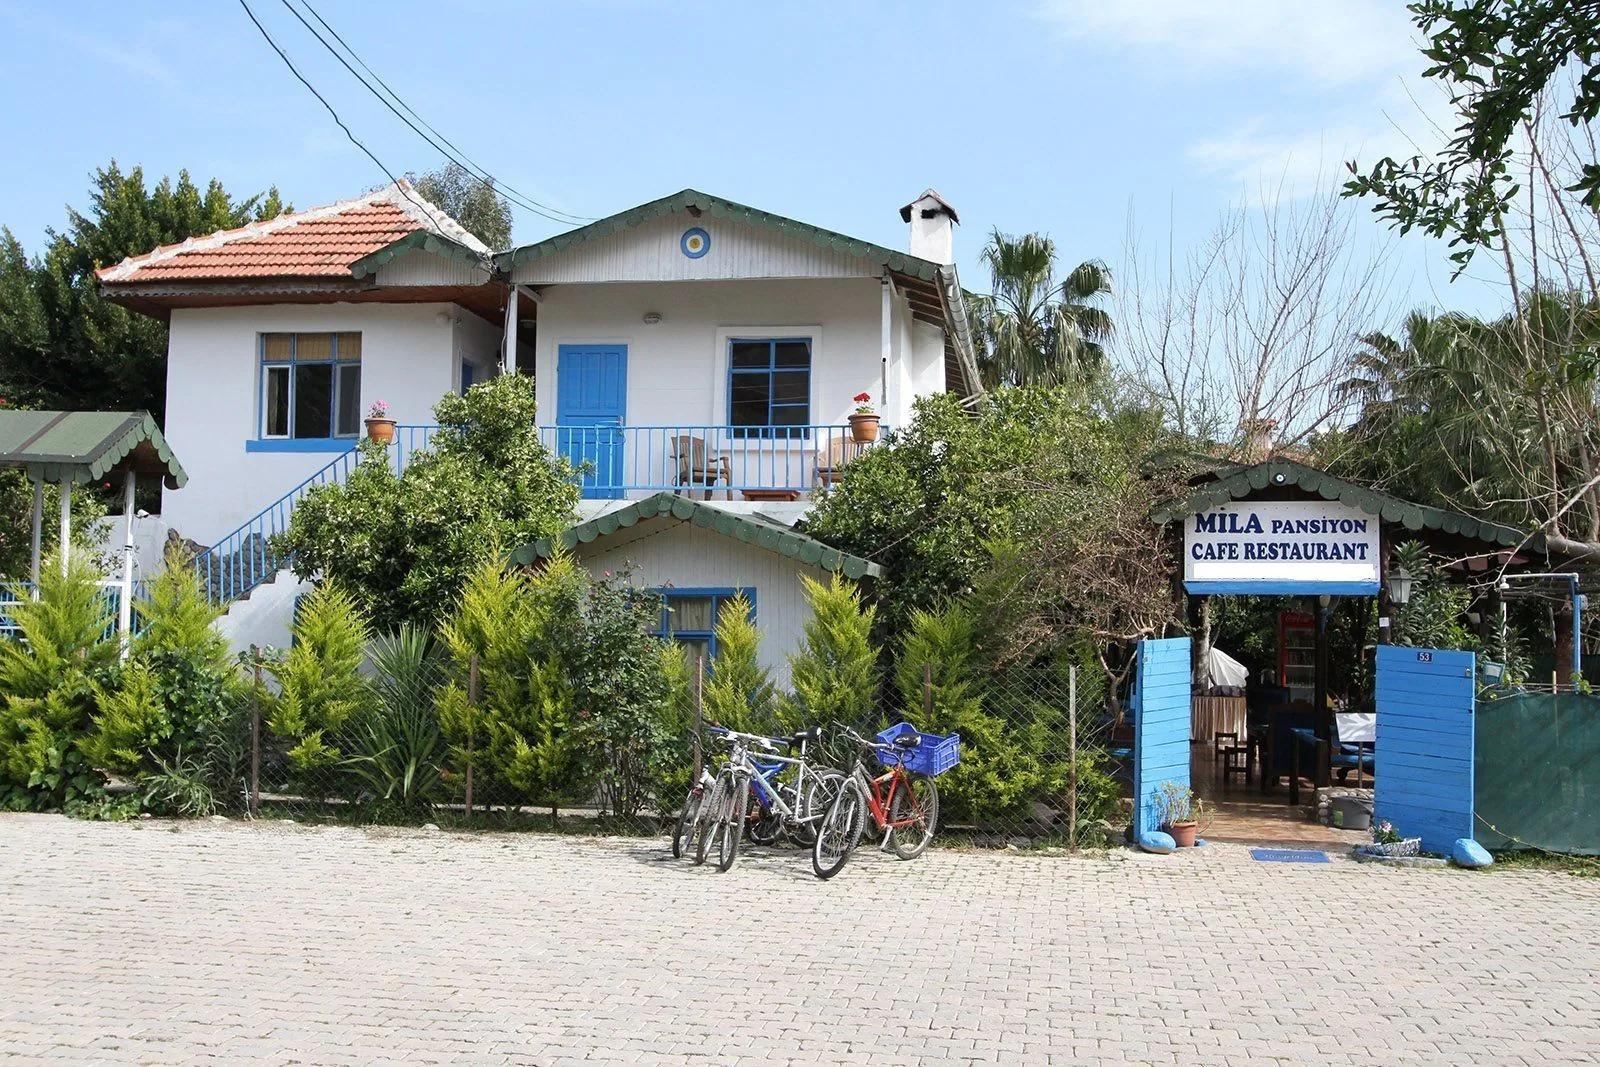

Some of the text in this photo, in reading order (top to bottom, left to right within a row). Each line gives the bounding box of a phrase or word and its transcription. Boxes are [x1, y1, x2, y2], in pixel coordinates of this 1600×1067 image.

[1271, 516, 1367, 534] PANSİYON
[1192, 542, 1369, 560] CAFE RESTAURANT
[1419, 652, 1430, 661] 53
